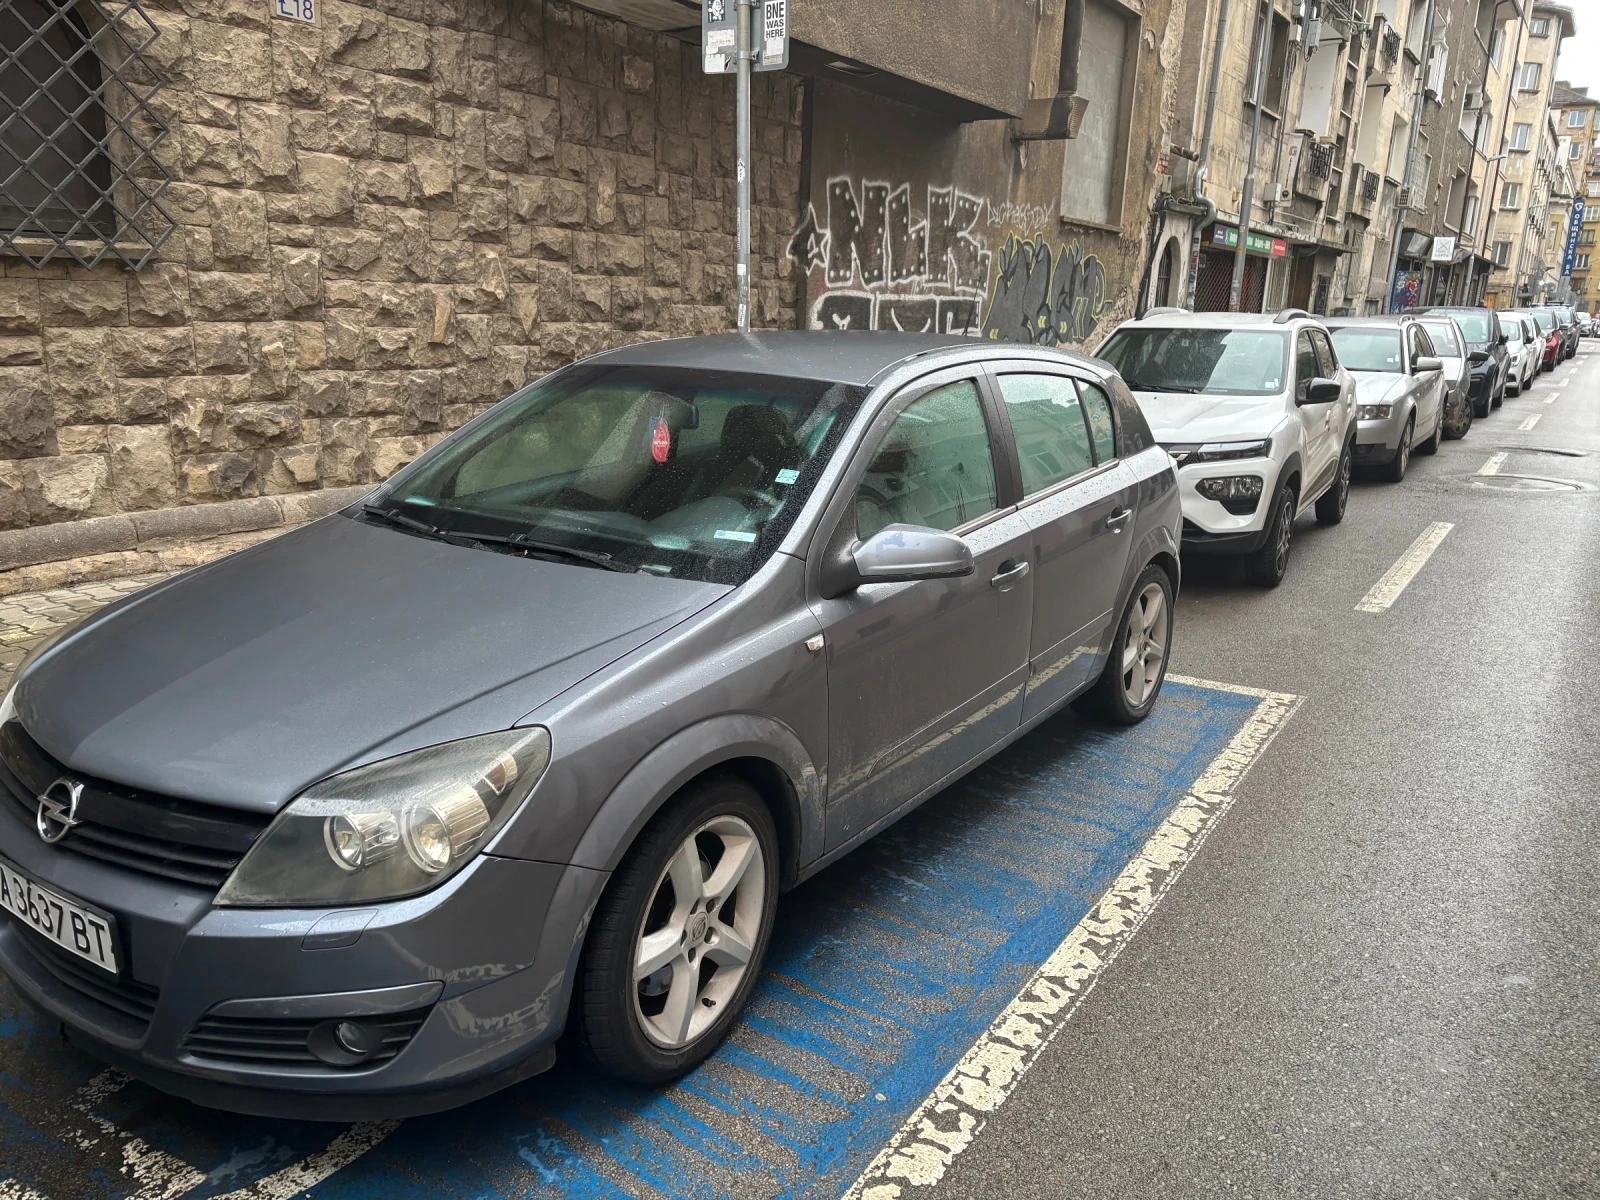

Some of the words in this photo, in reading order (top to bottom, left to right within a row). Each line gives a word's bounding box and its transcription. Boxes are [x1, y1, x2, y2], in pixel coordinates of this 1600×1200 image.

[766, 2, 785, 19] BNE
[766, 19, 784, 29] WAS
[765, 28, 784, 39] HERE
[1566, 213, 1580, 260] ОБЩИНСКА
